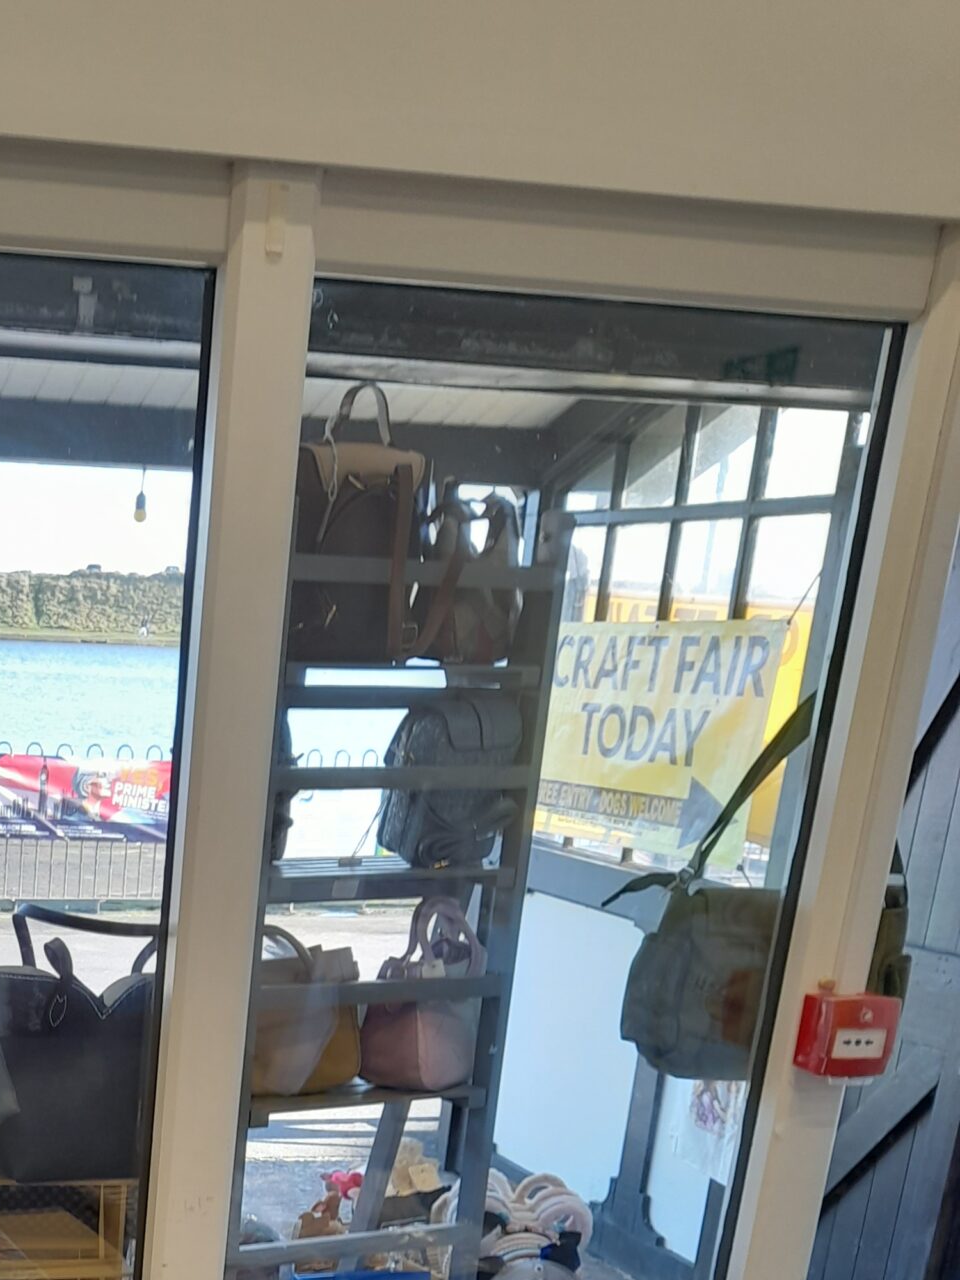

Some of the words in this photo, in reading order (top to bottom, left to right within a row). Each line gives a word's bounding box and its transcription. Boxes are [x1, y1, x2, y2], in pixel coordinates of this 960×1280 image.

[552, 633, 669, 691] CRAFT
[673, 634, 770, 698] FAIR
[580, 702, 711, 767] TODAY
[111, 793, 168, 813] MINISTE
[114, 781, 157, 800] PRIME
[538, 781, 557, 804] REE
[559, 785, 593, 811] ENTRY
[598, 791, 627, 816] DOGS
[629, 795, 683, 823] WELCOME
